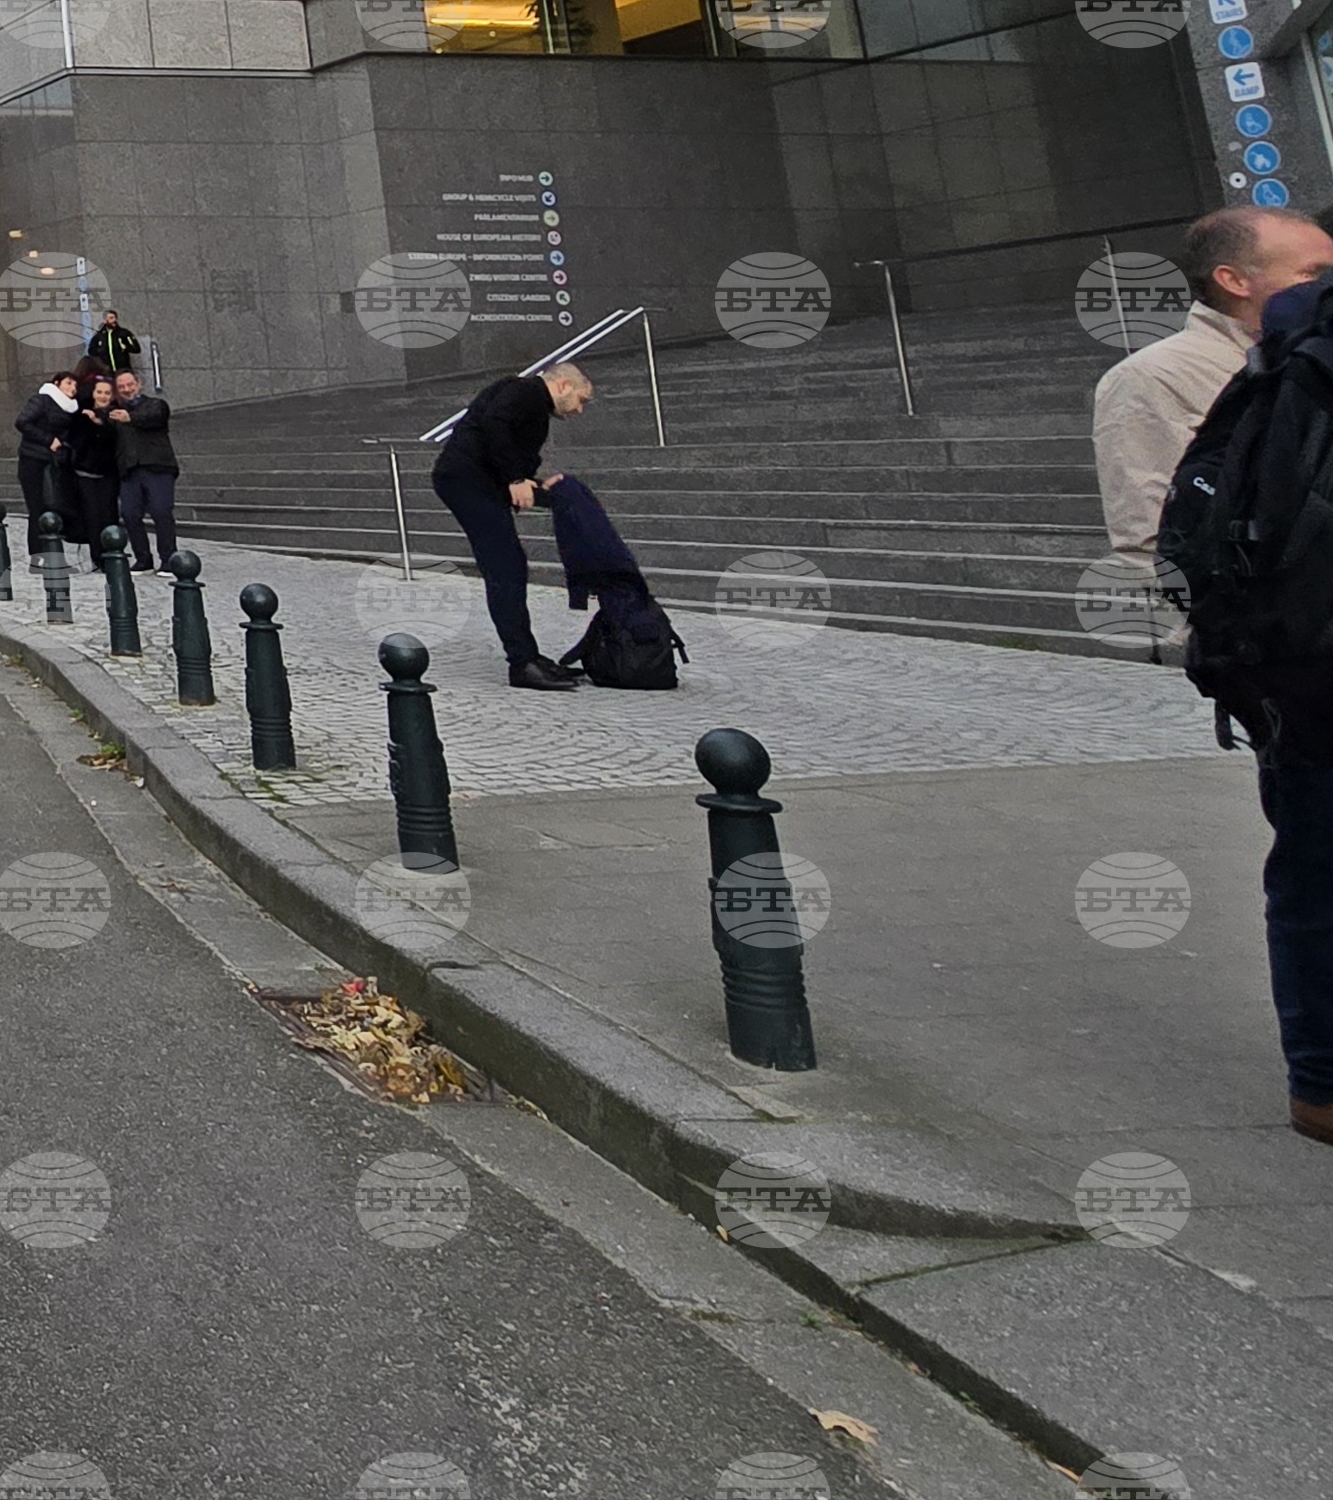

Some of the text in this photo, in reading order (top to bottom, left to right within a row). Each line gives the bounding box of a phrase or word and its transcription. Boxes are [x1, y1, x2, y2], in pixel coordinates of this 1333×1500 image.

[1234, 86, 1260, 97] RAMP
[442, 193, 468, 201] GROUP
[436, 233, 462, 241] HOUSE
[462, 233, 472, 241] OF
[473, 233, 511, 241] EUROPEAN
[439, 253, 467, 261] EUROPE
